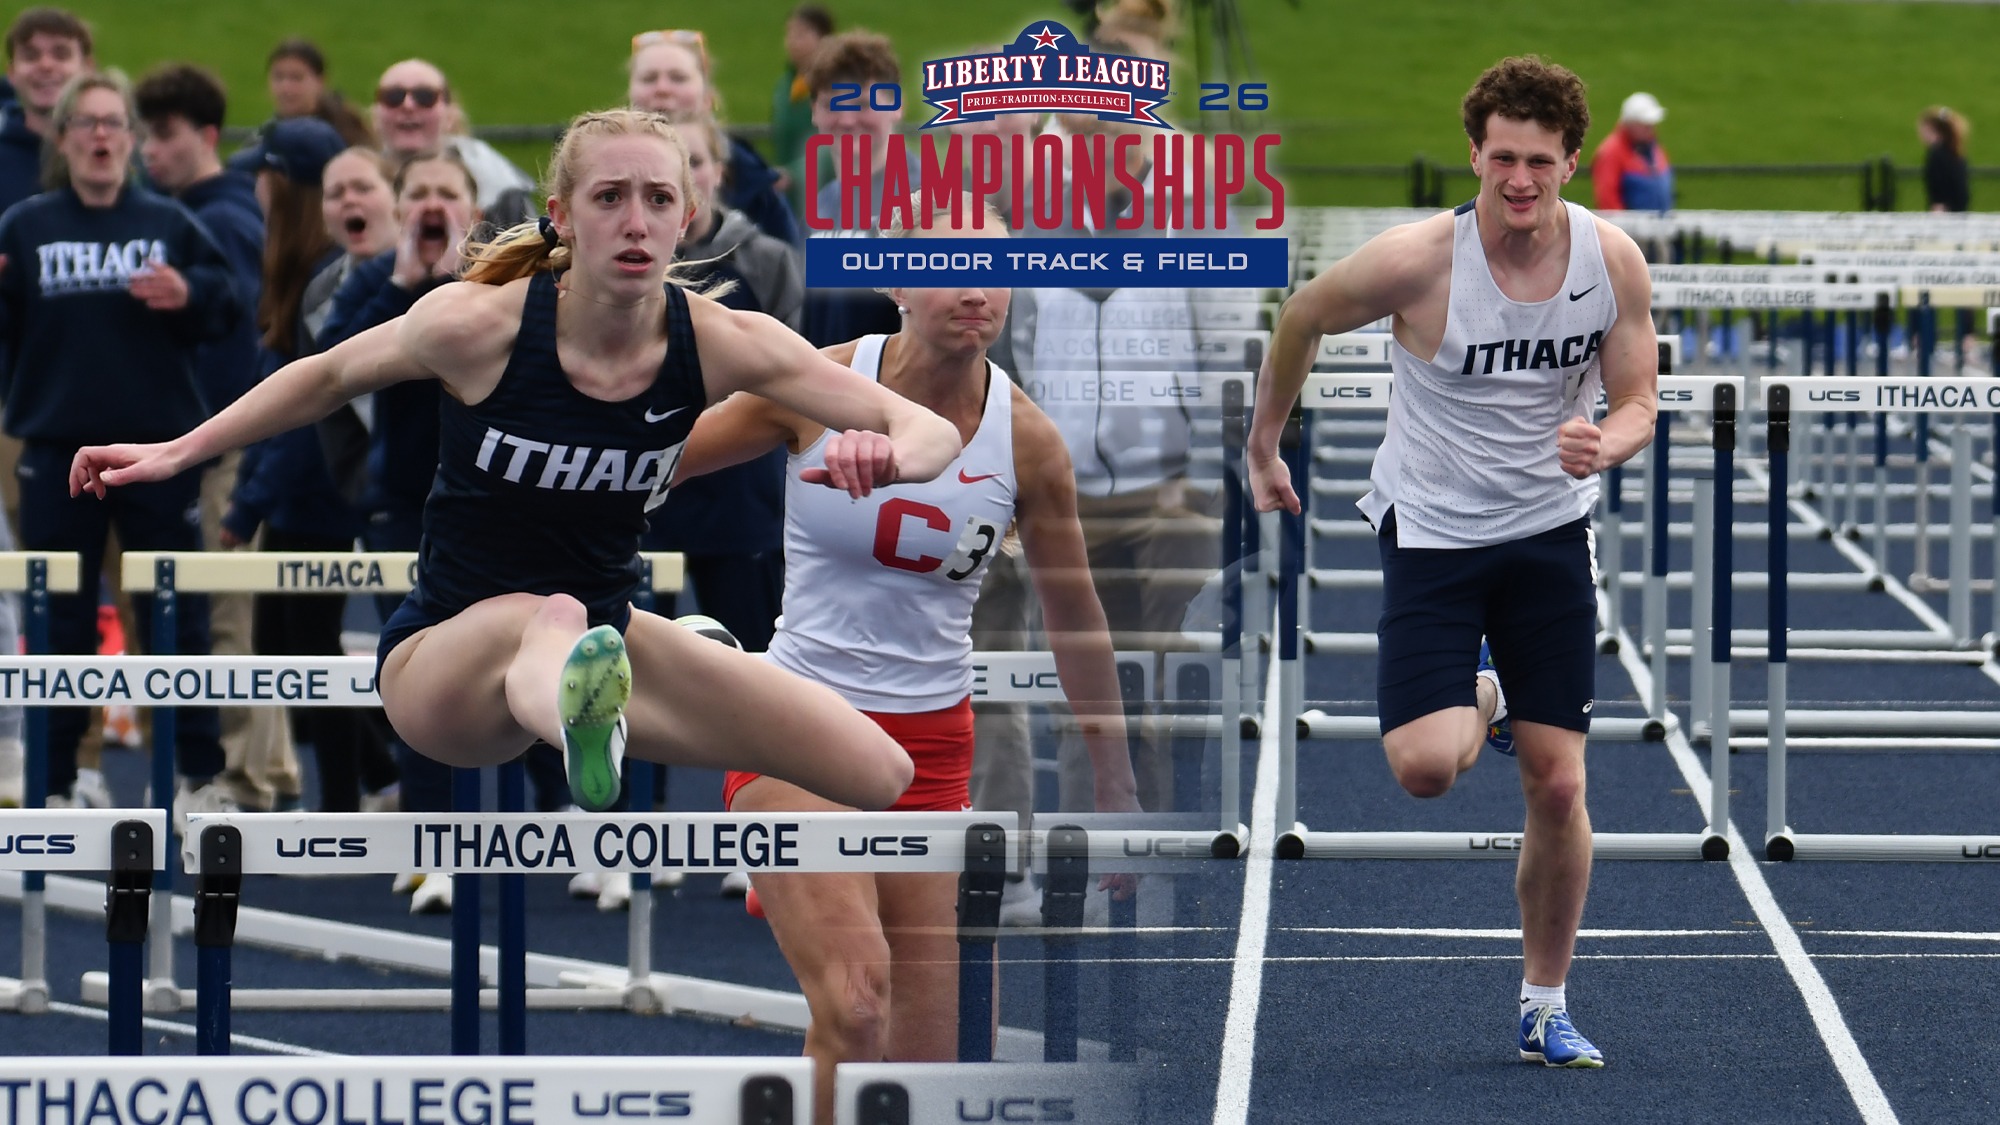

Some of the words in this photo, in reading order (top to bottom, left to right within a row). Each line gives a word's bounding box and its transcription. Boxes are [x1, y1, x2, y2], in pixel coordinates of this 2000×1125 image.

[36, 238, 166, 281] ITHACA
[1652, 270, 1698, 283] THACA
[1676, 288, 1735, 304] ITHACA
[1741, 288, 1816, 305] COLLEGE
[1325, 345, 1369, 356] UCS
[1461, 330, 1604, 375] ITHACA
[1028, 380, 1135, 402] OLLEGE
[1150, 385, 1203, 398] UCS
[1320, 386, 1372, 398] UCS
[1657, 389, 1693, 402] CS
[1808, 389, 1861, 402] UCS
[1876, 384, 1978, 408] ITHACA
[475, 426, 664, 492] ITHAC
[872, 497, 951, 574] C
[946, 524, 996, 581] 3
[277, 560, 384, 588] ITHACA
[143, 667, 329, 700] COLLEGE
[1010, 672, 1060, 689] UC
[276, 837, 368, 858] UCS
[413, 823, 576, 868] ITHACA
[593, 822, 799, 868] COLLEGE
[838, 835, 929, 856] UCS
[234, 1078, 536, 1125] COLLEGE
[572, 1090, 692, 1118] UCS
[959, 1098, 1076, 1122] UCS
